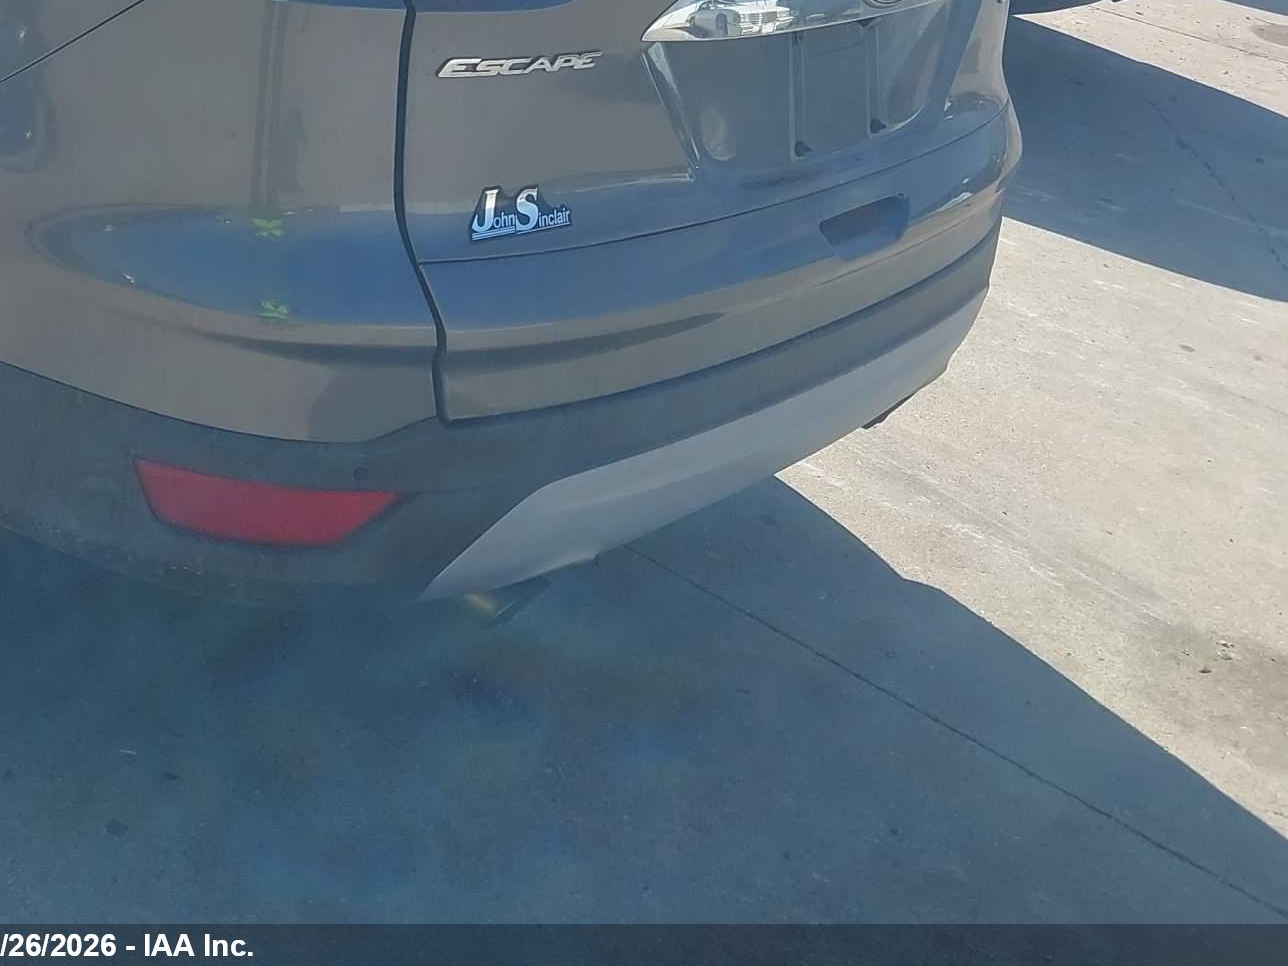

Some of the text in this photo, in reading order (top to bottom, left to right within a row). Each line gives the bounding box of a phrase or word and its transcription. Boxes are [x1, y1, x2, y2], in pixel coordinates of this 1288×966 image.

[438, 50, 603, 78] ESCAPE
[472, 187, 571, 233] John Sinclair
